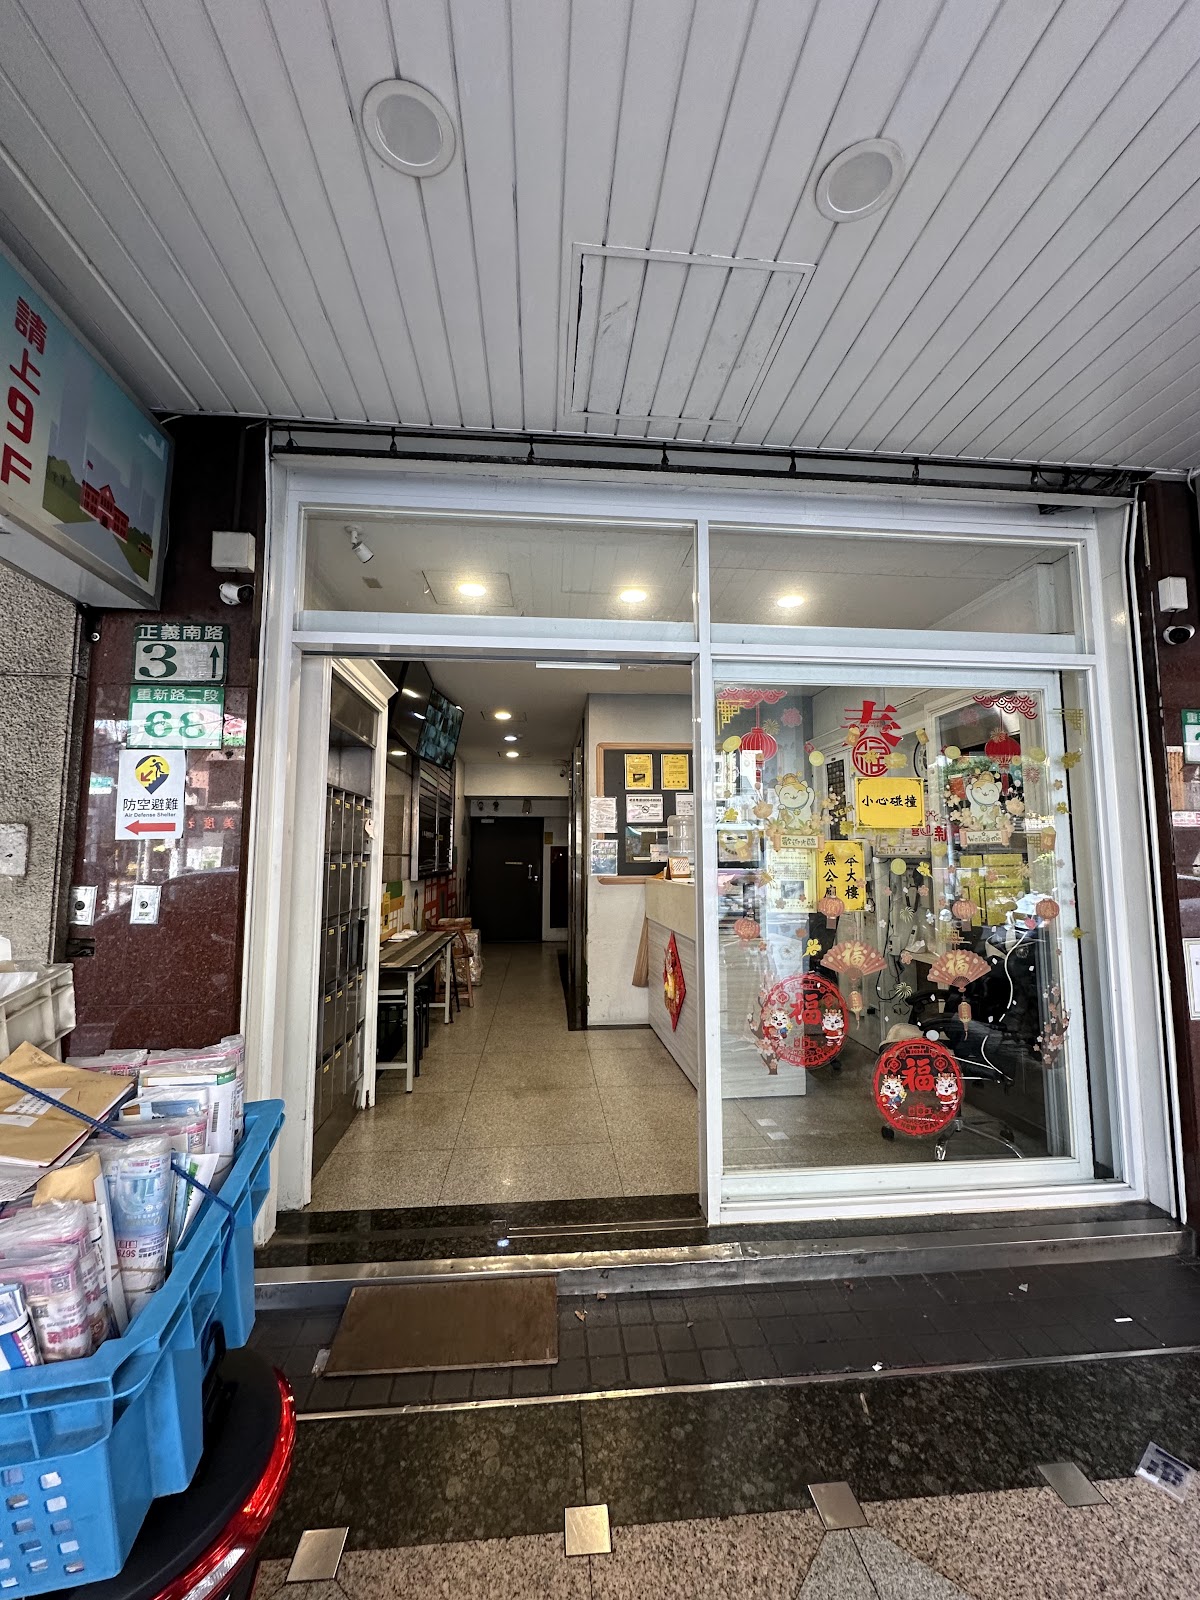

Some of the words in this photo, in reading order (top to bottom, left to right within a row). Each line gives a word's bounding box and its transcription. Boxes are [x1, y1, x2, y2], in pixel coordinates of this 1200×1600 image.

[138, 624, 223, 640] 正義南路
[139, 643, 177, 678] 3
[137, 688, 219, 702] 重新路二段
[144, 710, 206, 738] 68
[123, 798, 178, 811] 防空避難
[862, 795, 917, 807] 小心碰撞
[781, 836, 816, 846] 歡迎光臨
[789, 992, 822, 1025] 福
[902, 1058, 935, 1092] 福
